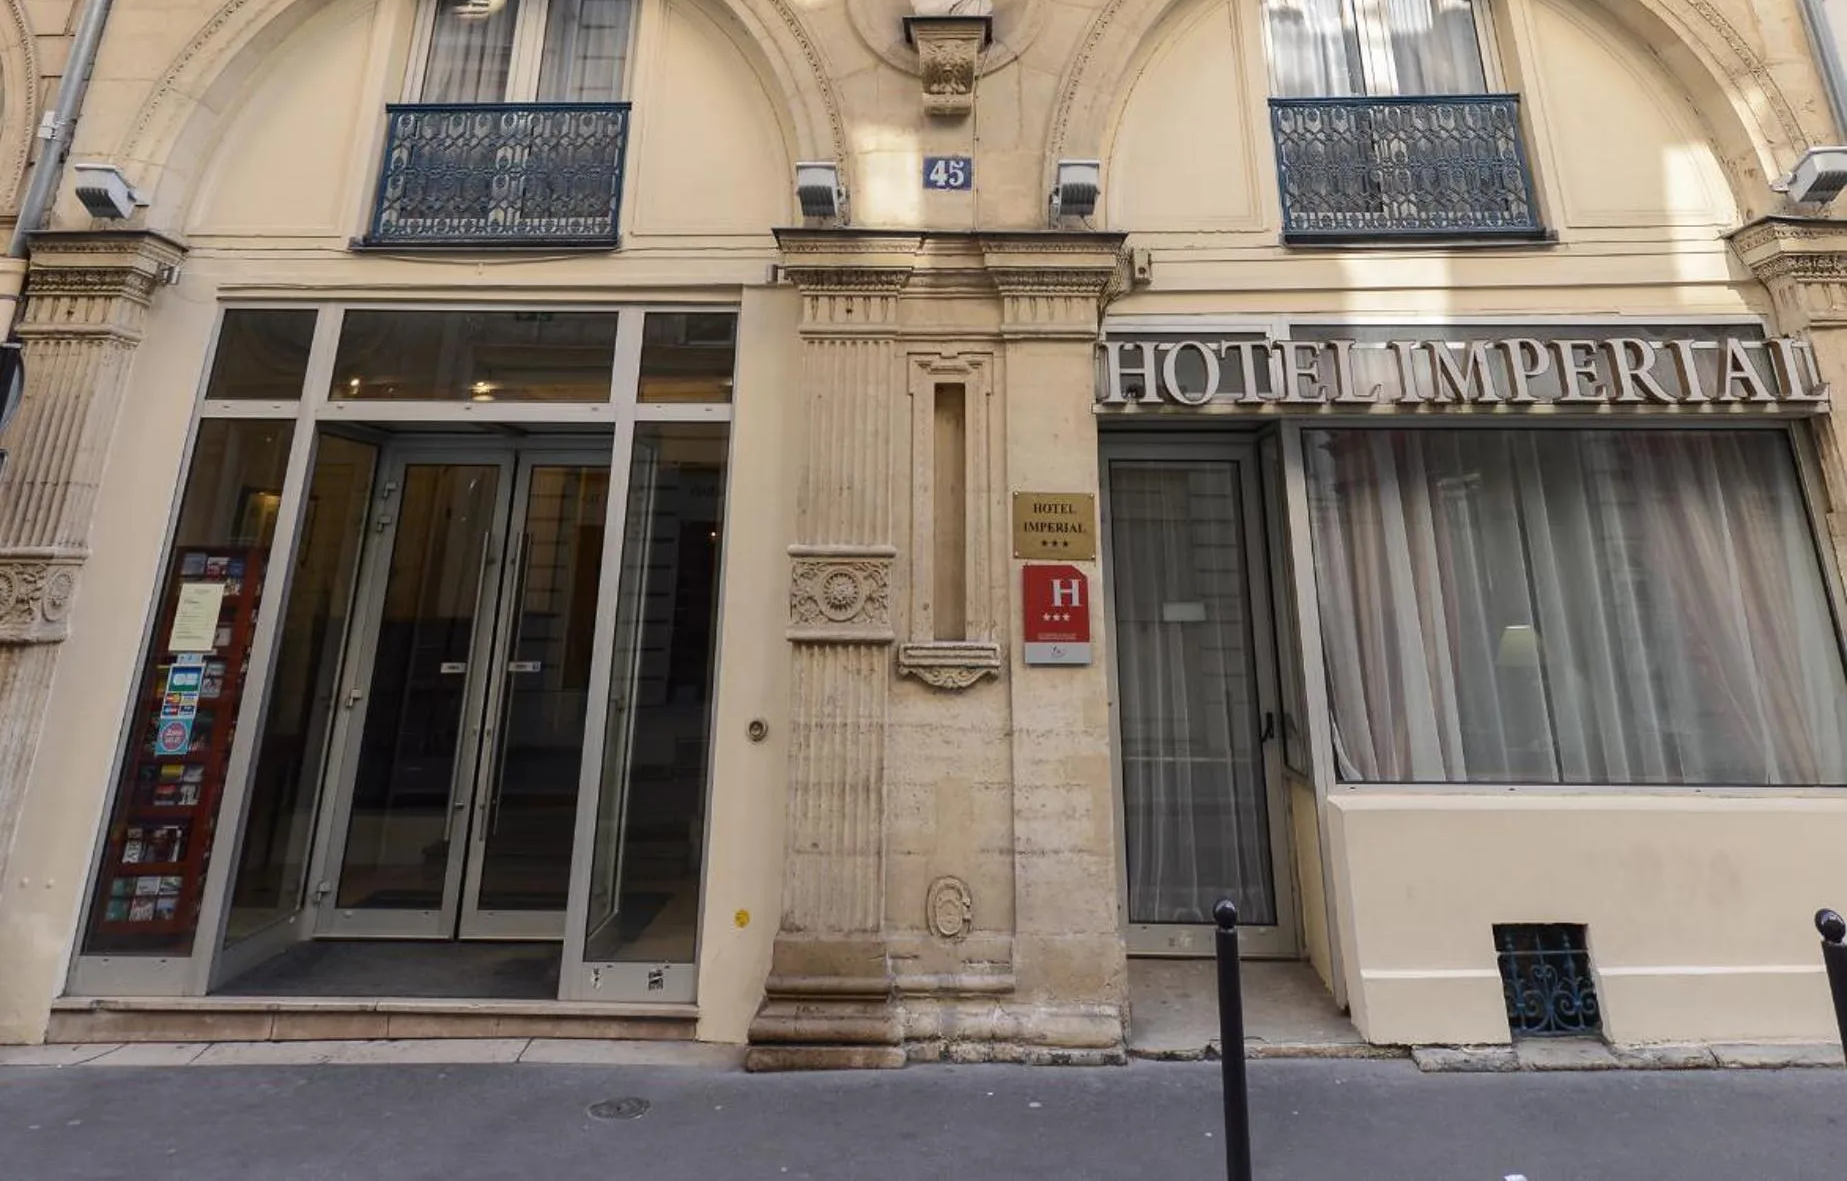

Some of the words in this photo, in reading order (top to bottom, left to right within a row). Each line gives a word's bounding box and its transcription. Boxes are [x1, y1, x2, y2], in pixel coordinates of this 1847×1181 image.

[930, 160, 964, 186] 45
[1101, 338, 1382, 405] HOTEL
[1388, 337, 1829, 404] IMPERIAL
[1033, 503, 1077, 514] HOTEL
[1024, 522, 1085, 533] IMPERIAL
[1052, 579, 1082, 606] H
